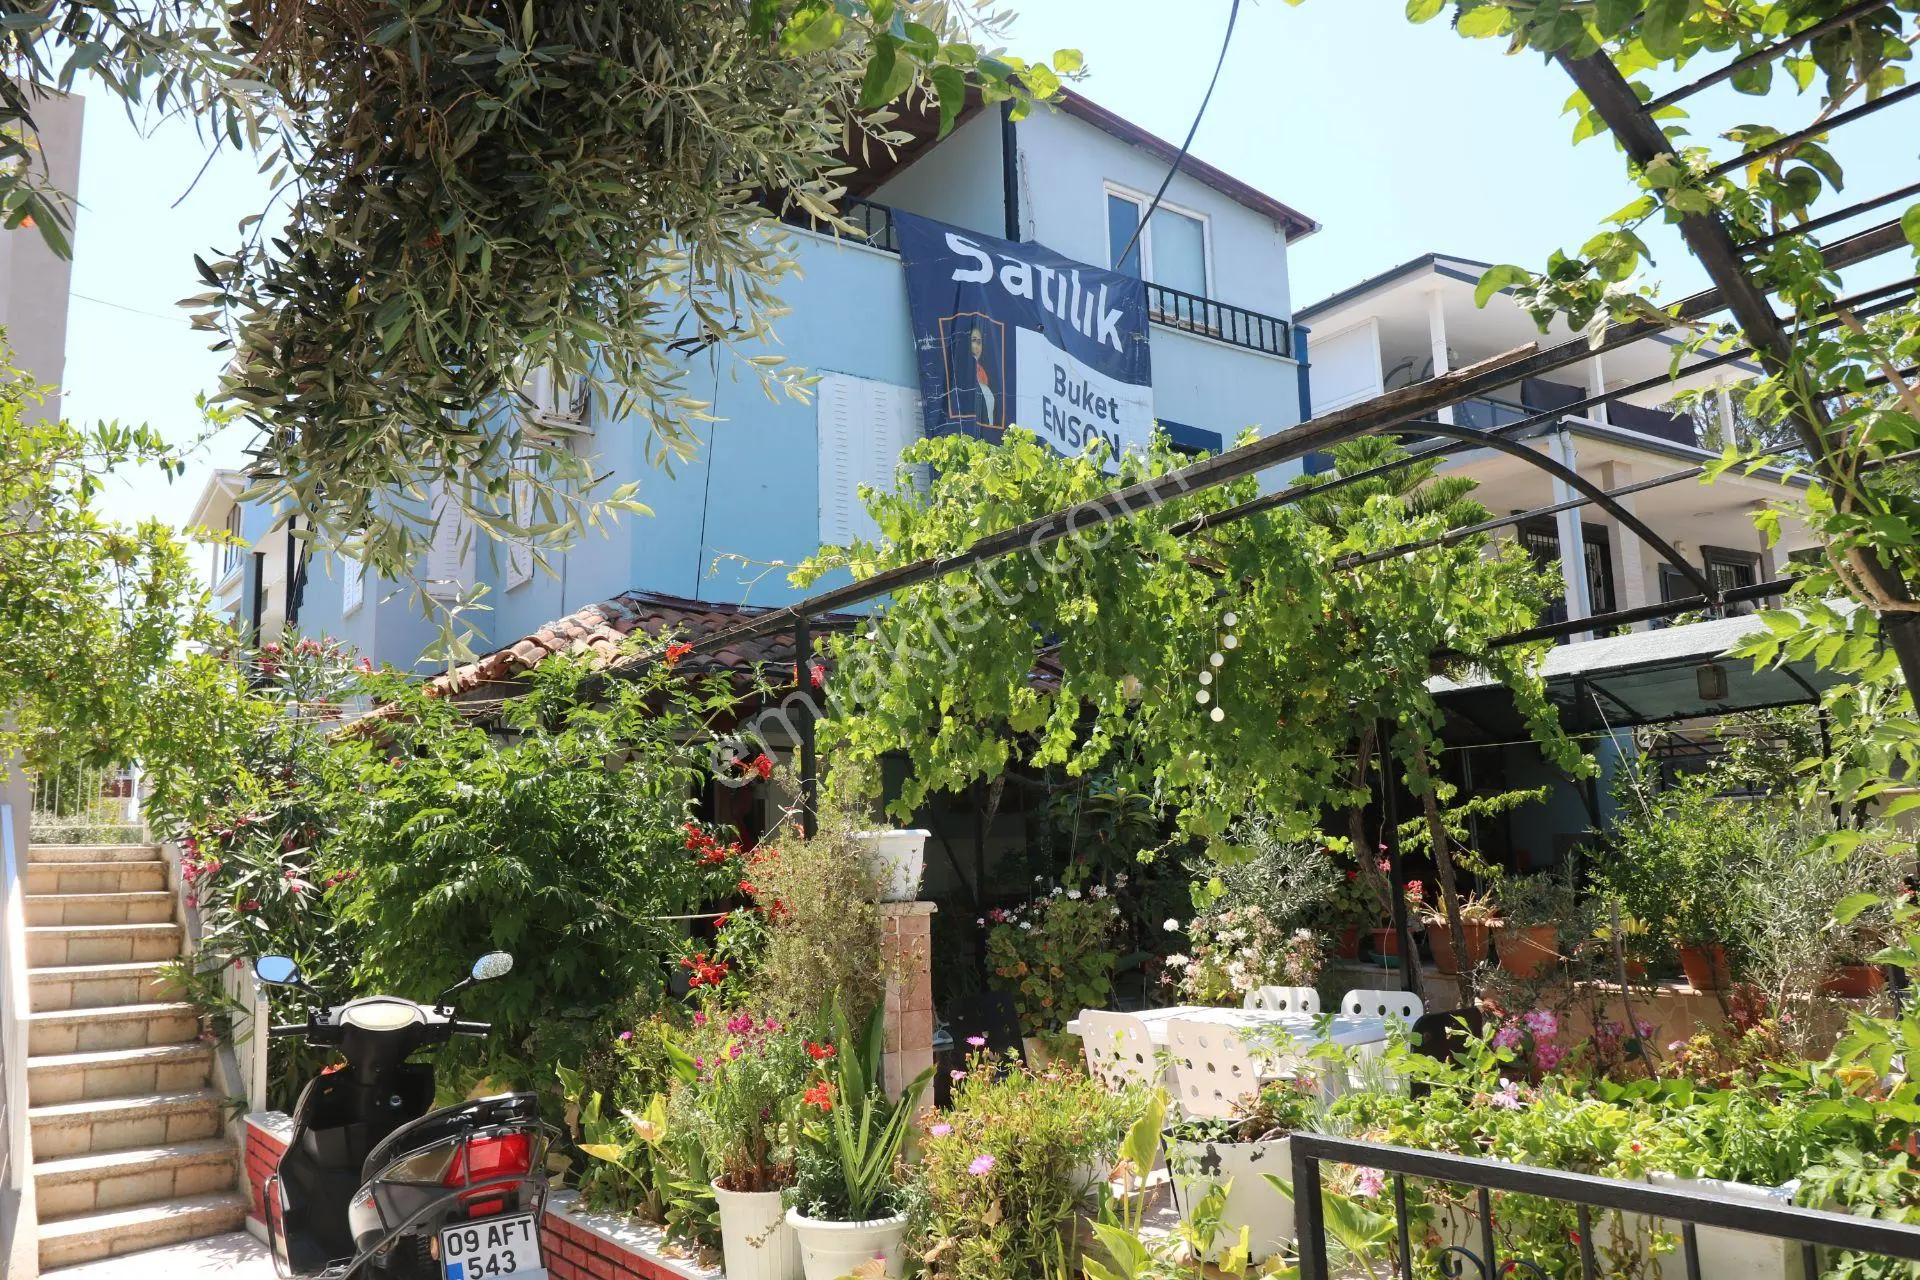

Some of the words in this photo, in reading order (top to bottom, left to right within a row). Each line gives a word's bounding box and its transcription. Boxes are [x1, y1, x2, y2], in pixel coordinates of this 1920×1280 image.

[945, 232, 1124, 354] Satılık
[1053, 363, 1120, 425] Buket
[447, 1229, 480, 1256] 09
[487, 1220, 531, 1249] AFT
[467, 1250, 517, 1280] 543
